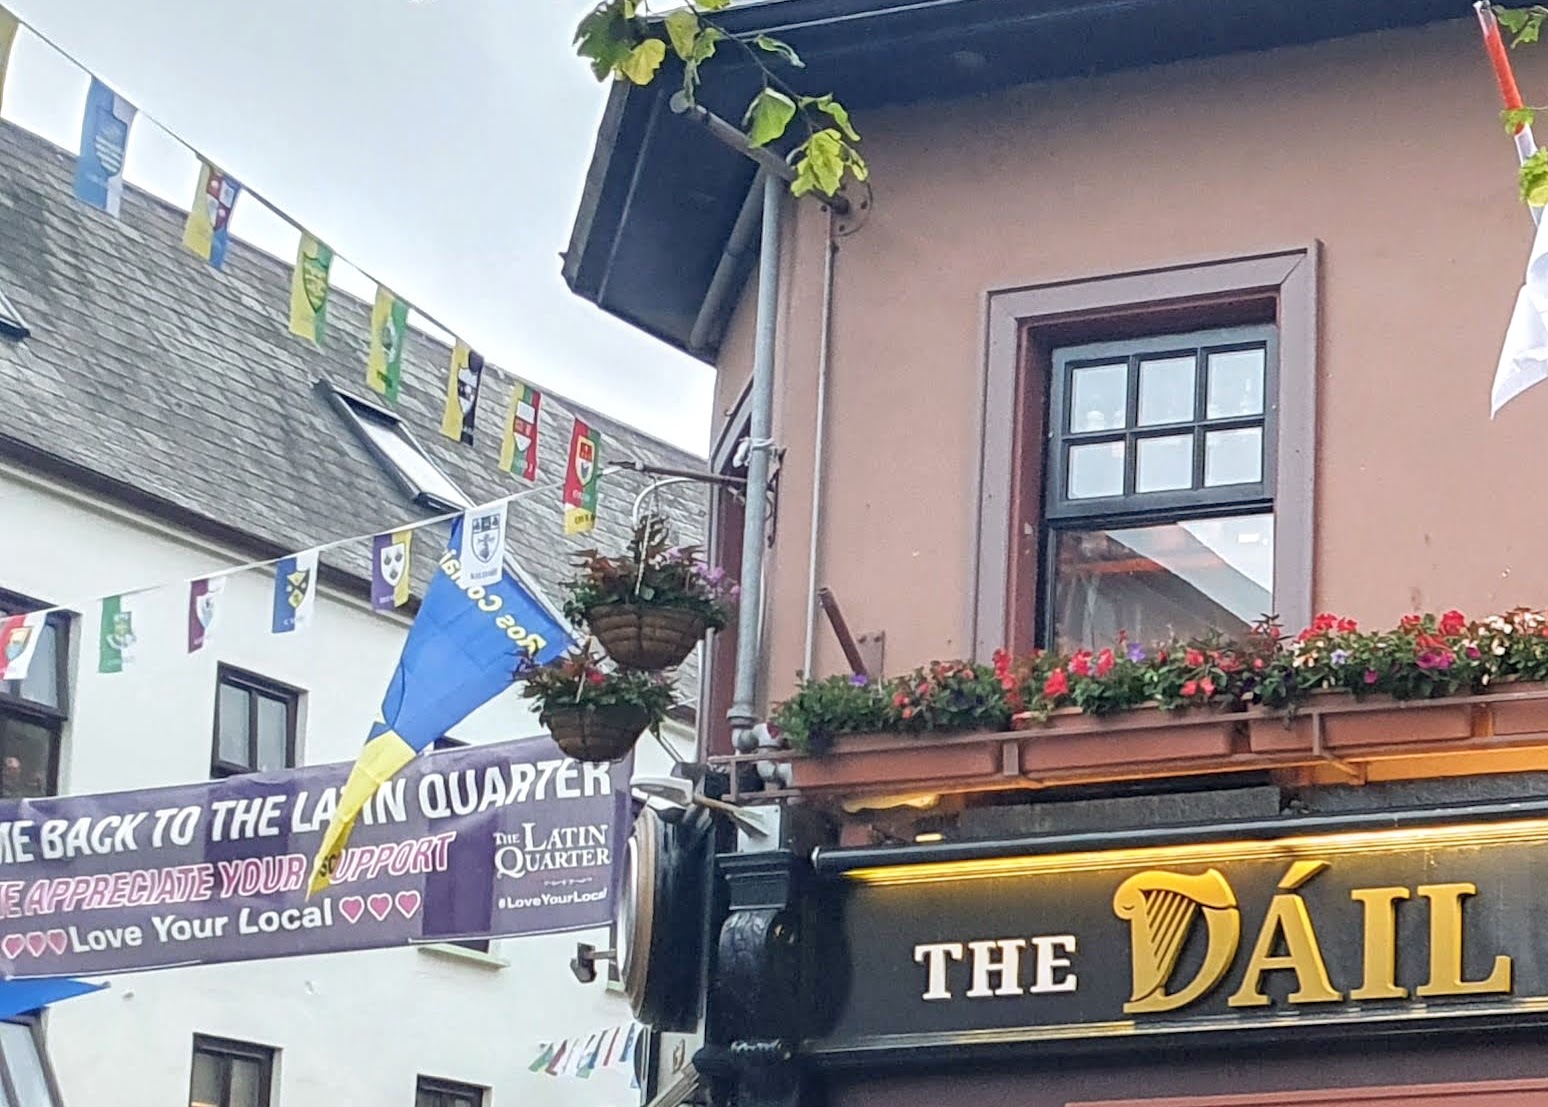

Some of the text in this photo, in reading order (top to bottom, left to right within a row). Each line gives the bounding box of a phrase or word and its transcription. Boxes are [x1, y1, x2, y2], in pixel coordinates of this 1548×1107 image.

[40, 812, 147, 860] BACK
[152, 805, 201, 848] TO
[211, 795, 287, 842] THE
[291, 778, 407, 833] LAIN
[418, 758, 611, 820] QUARTER
[493, 822, 608, 852] THE LATIN
[0, 881, 25, 919] E
[24, 863, 215, 917] APPRECIATE
[219, 853, 308, 899] YOUR
[328, 832, 457, 885] UPPORT
[494, 846, 613, 879] QUARTER
[70, 898, 333, 953] Love Your Local
[914, 934, 1078, 1001] THE
[1113, 860, 1513, 1015] DÁIL
